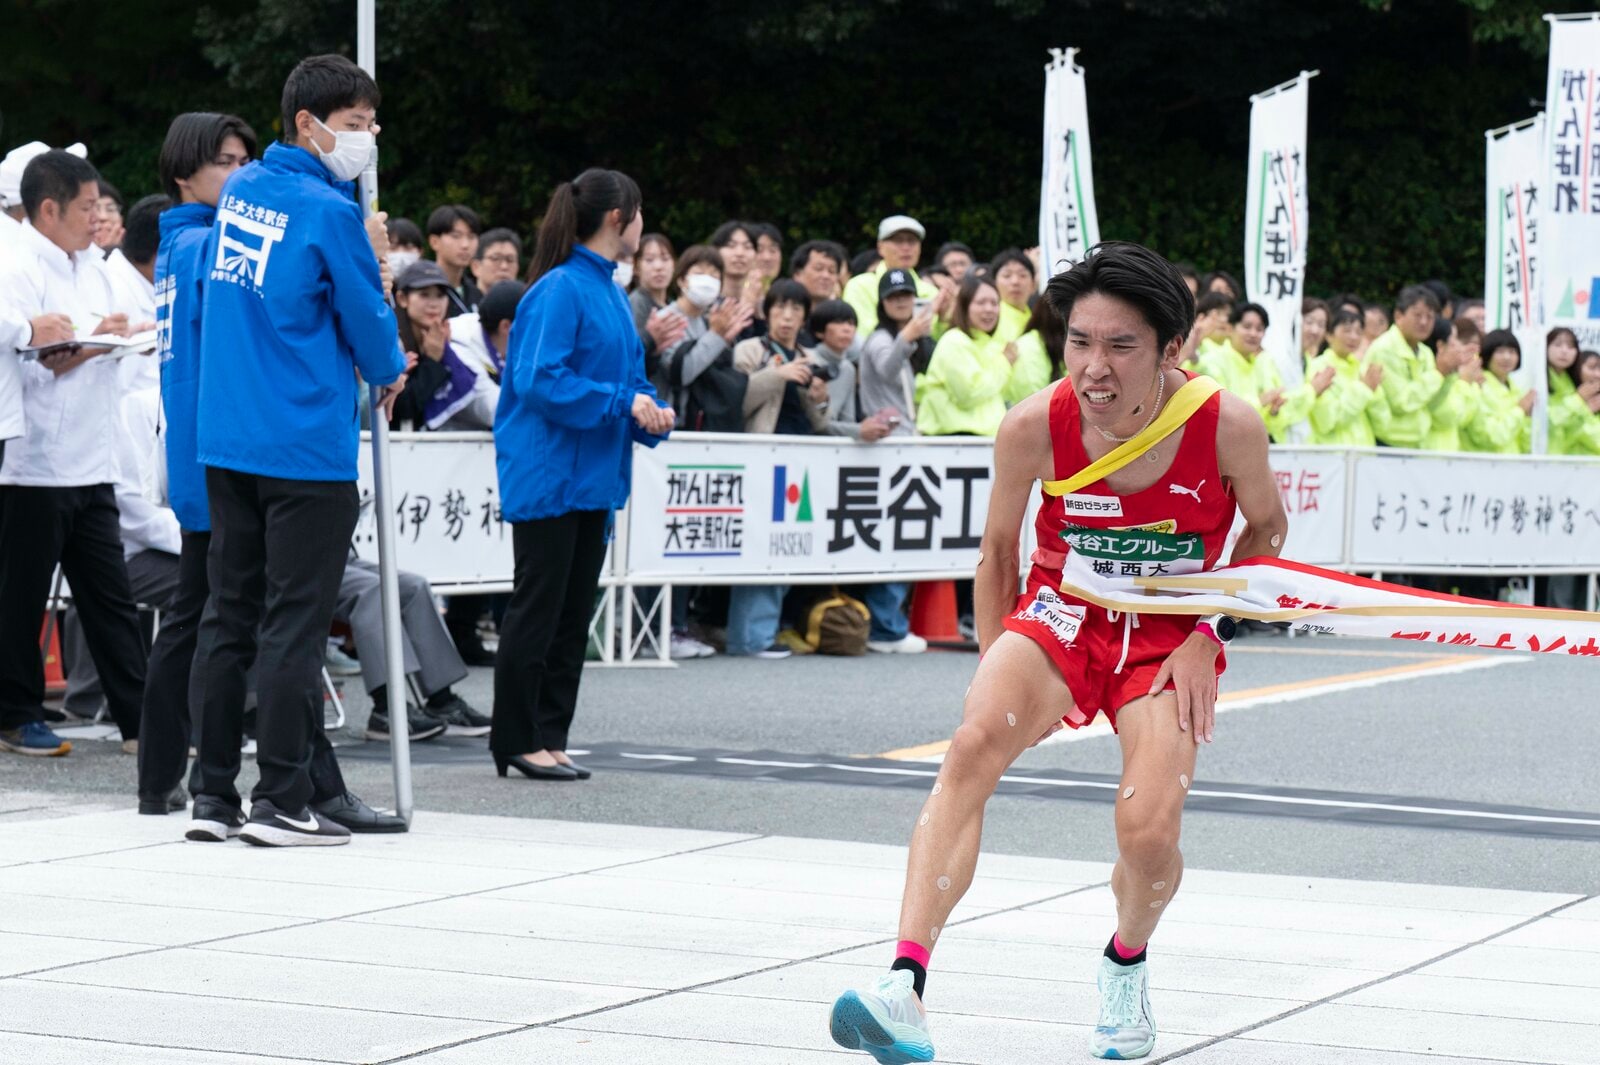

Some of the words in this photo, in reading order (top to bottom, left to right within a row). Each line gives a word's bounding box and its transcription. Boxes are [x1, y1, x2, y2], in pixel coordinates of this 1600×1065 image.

[667, 472, 744, 505] がんばれ
[826, 465, 989, 553] 長谷工
[1065, 499, 1120, 511] 新田ゼラチン
[665, 516, 743, 550] 大学駅伝
[769, 532, 814, 557] HASEKO
[1092, 560, 1171, 578] 城西大
[1044, 609, 1077, 635] NITTA
